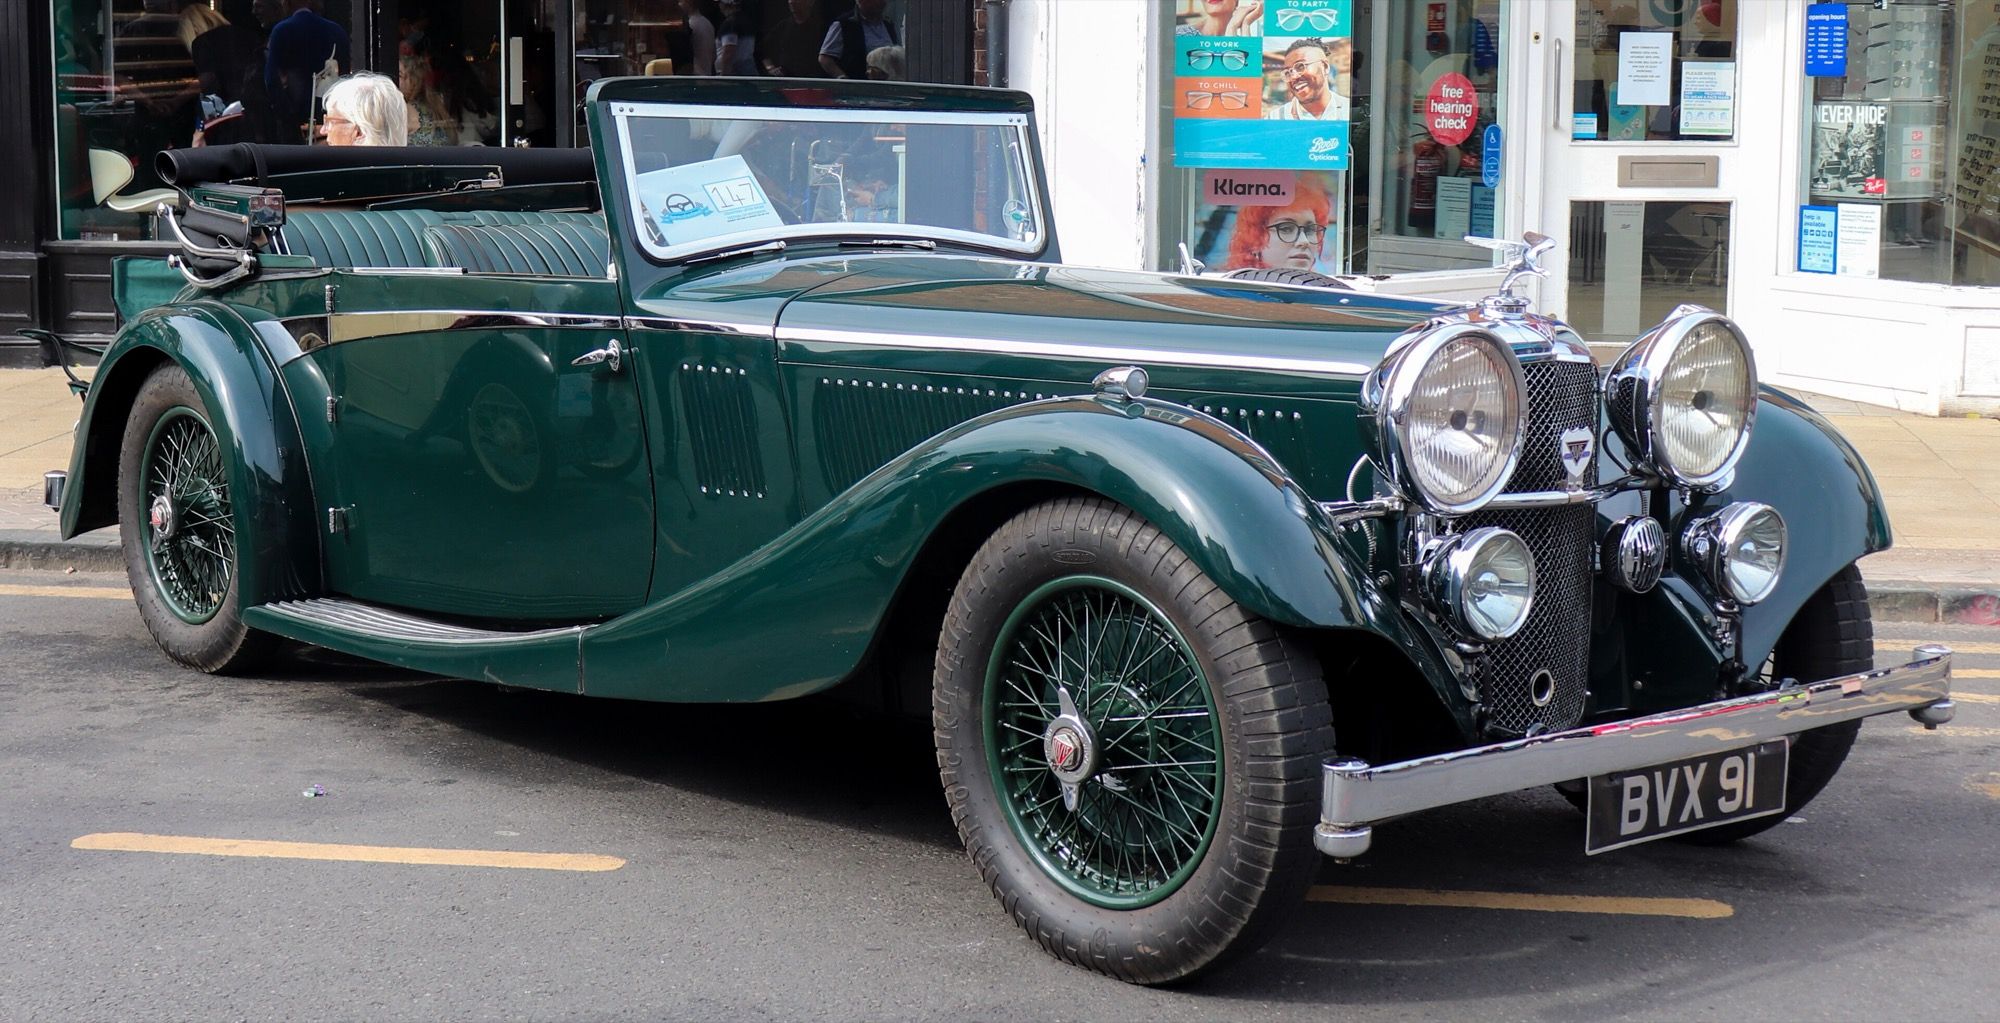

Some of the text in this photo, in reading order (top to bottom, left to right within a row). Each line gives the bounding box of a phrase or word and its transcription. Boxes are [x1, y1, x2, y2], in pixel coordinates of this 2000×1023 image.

[1287, 0, 1329, 8] TO PARTY
[1441, 84, 1464, 98] free
[1430, 99, 1473, 117] hearing
[1814, 104, 1885, 125] NEVER HIDE
[1434, 116, 1467, 130] check
[1309, 137, 1339, 152] Boots
[1308, 153, 1339, 162] Opticians
[711, 182, 755, 208] 147
[1213, 178, 1286, 196] Klarna.
[1619, 752, 1756, 836] BVX 91
